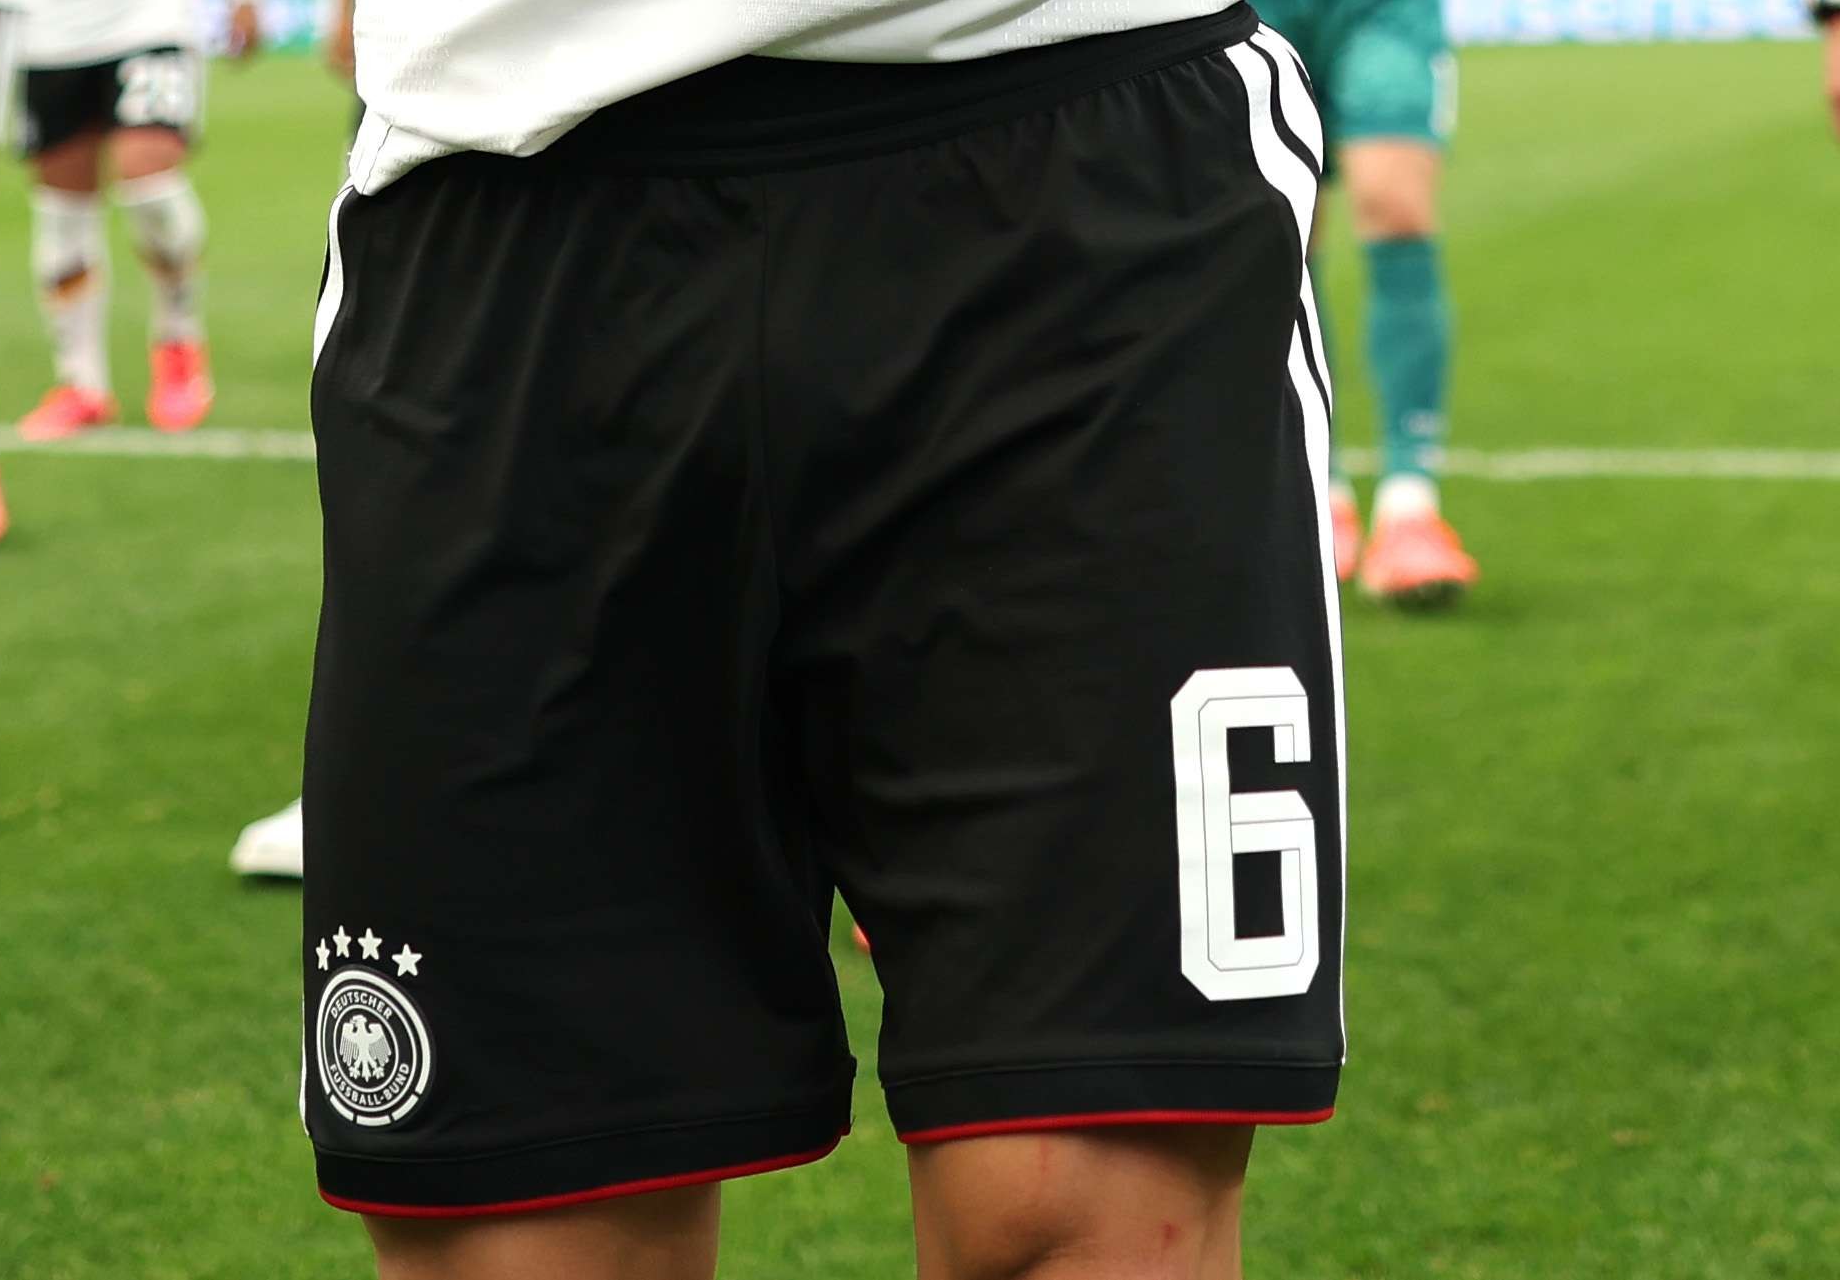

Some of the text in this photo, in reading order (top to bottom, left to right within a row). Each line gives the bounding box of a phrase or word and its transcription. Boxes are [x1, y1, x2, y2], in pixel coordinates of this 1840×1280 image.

[1170, 665, 1320, 1001] 6
[330, 991, 393, 1020] DEUTSCHER
[329, 1063, 410, 1106] FUSSBALL-BUND
